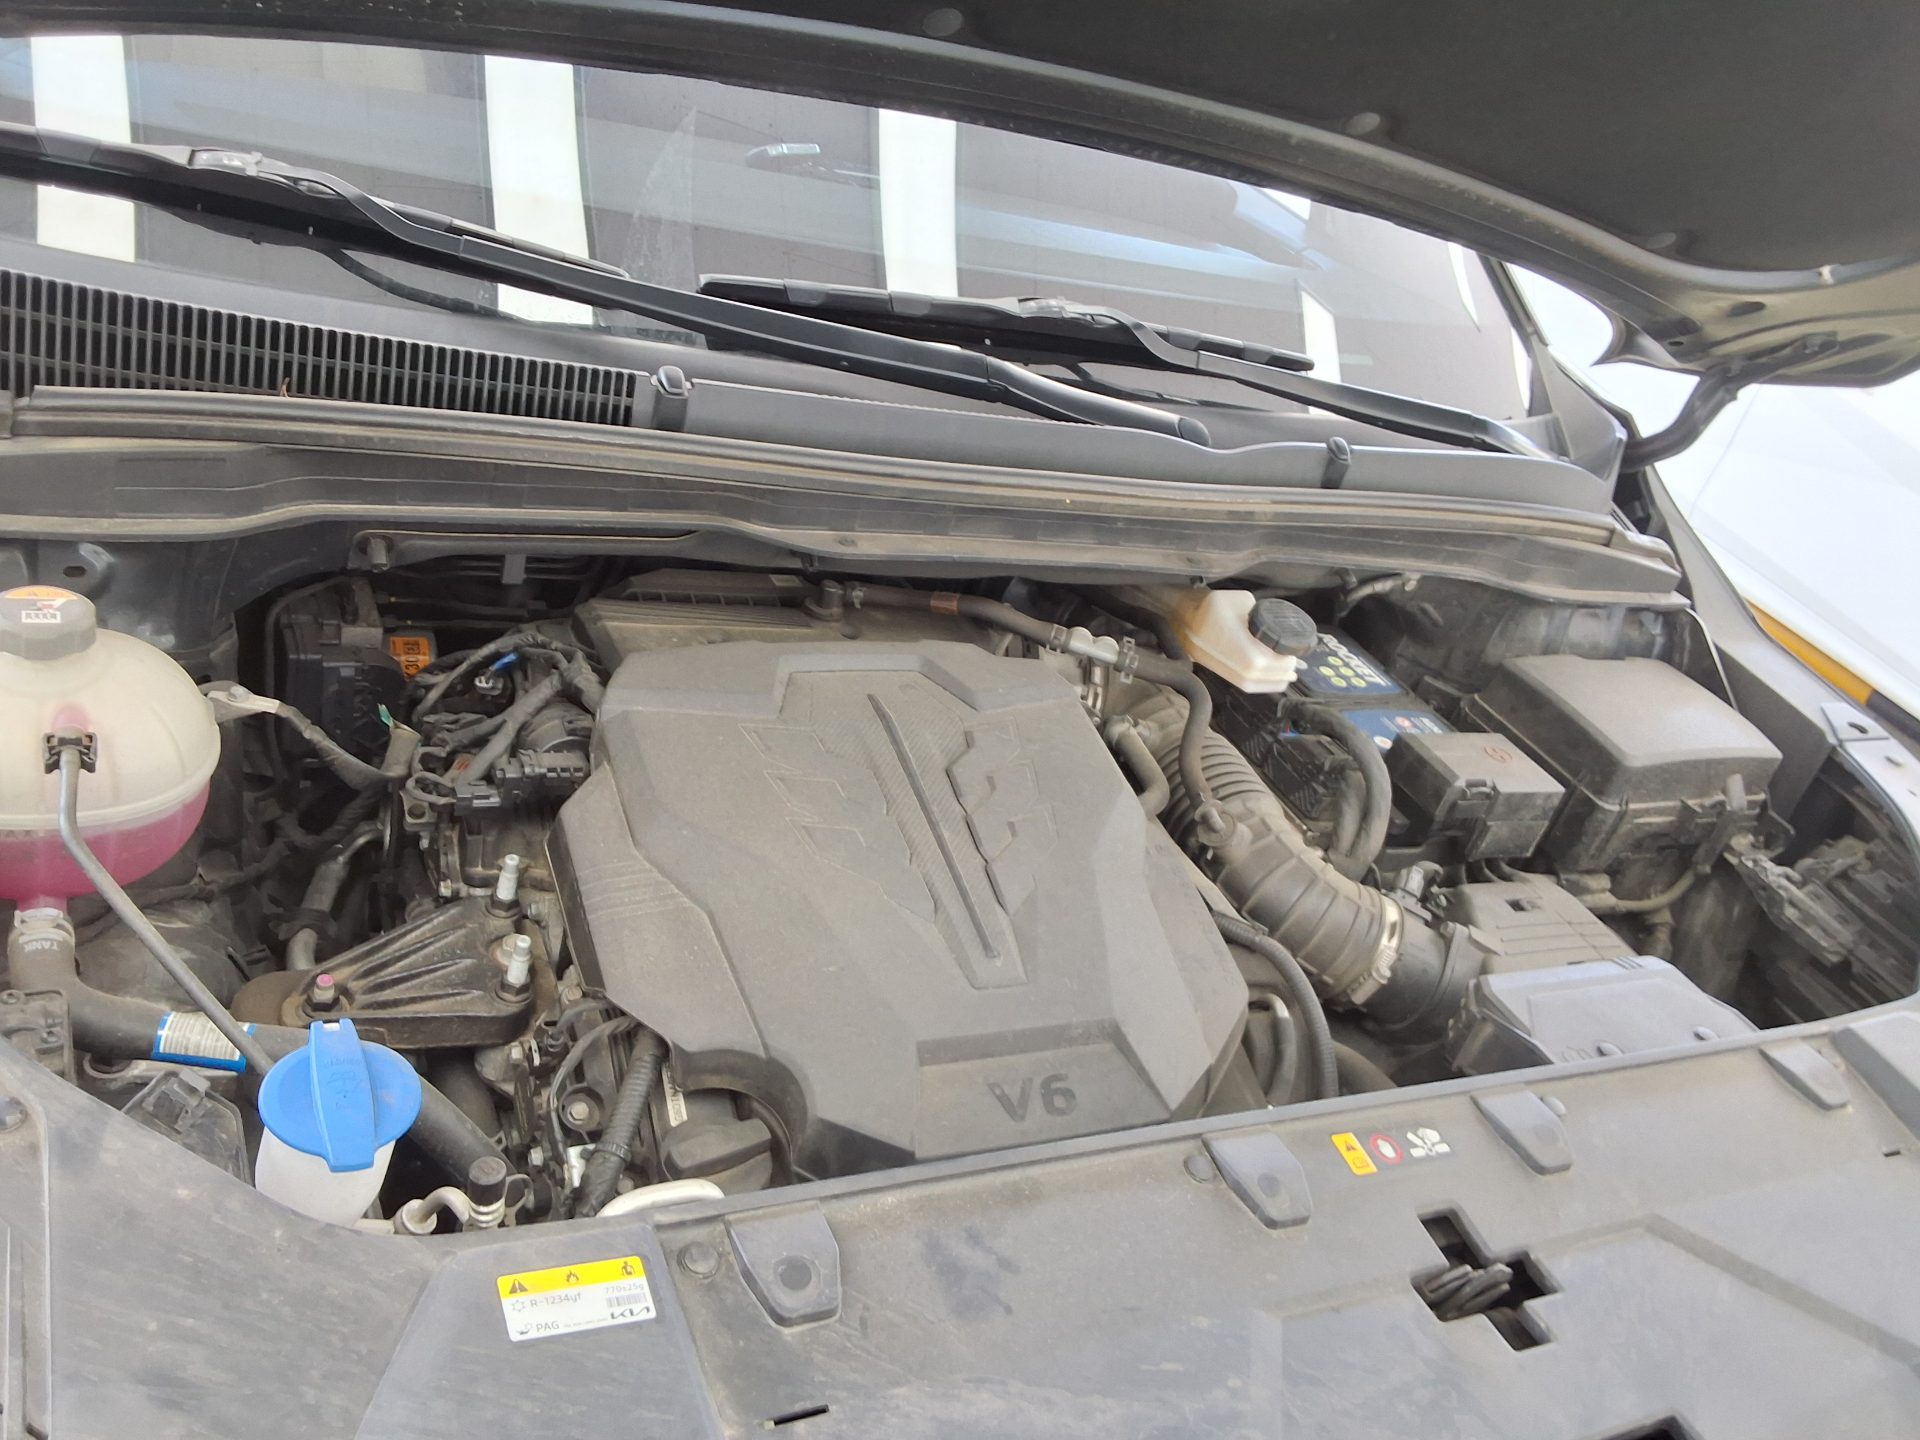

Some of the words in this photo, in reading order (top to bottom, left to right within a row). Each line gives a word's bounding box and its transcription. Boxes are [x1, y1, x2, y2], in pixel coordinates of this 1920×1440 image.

[1316, 632, 1387, 687] ROCKET
[23, 940, 58, 953] TANK
[987, 1073, 1077, 1122] V6
[530, 1292, 582, 1308] R-1234yf
[536, 1321, 560, 1333] PAG
